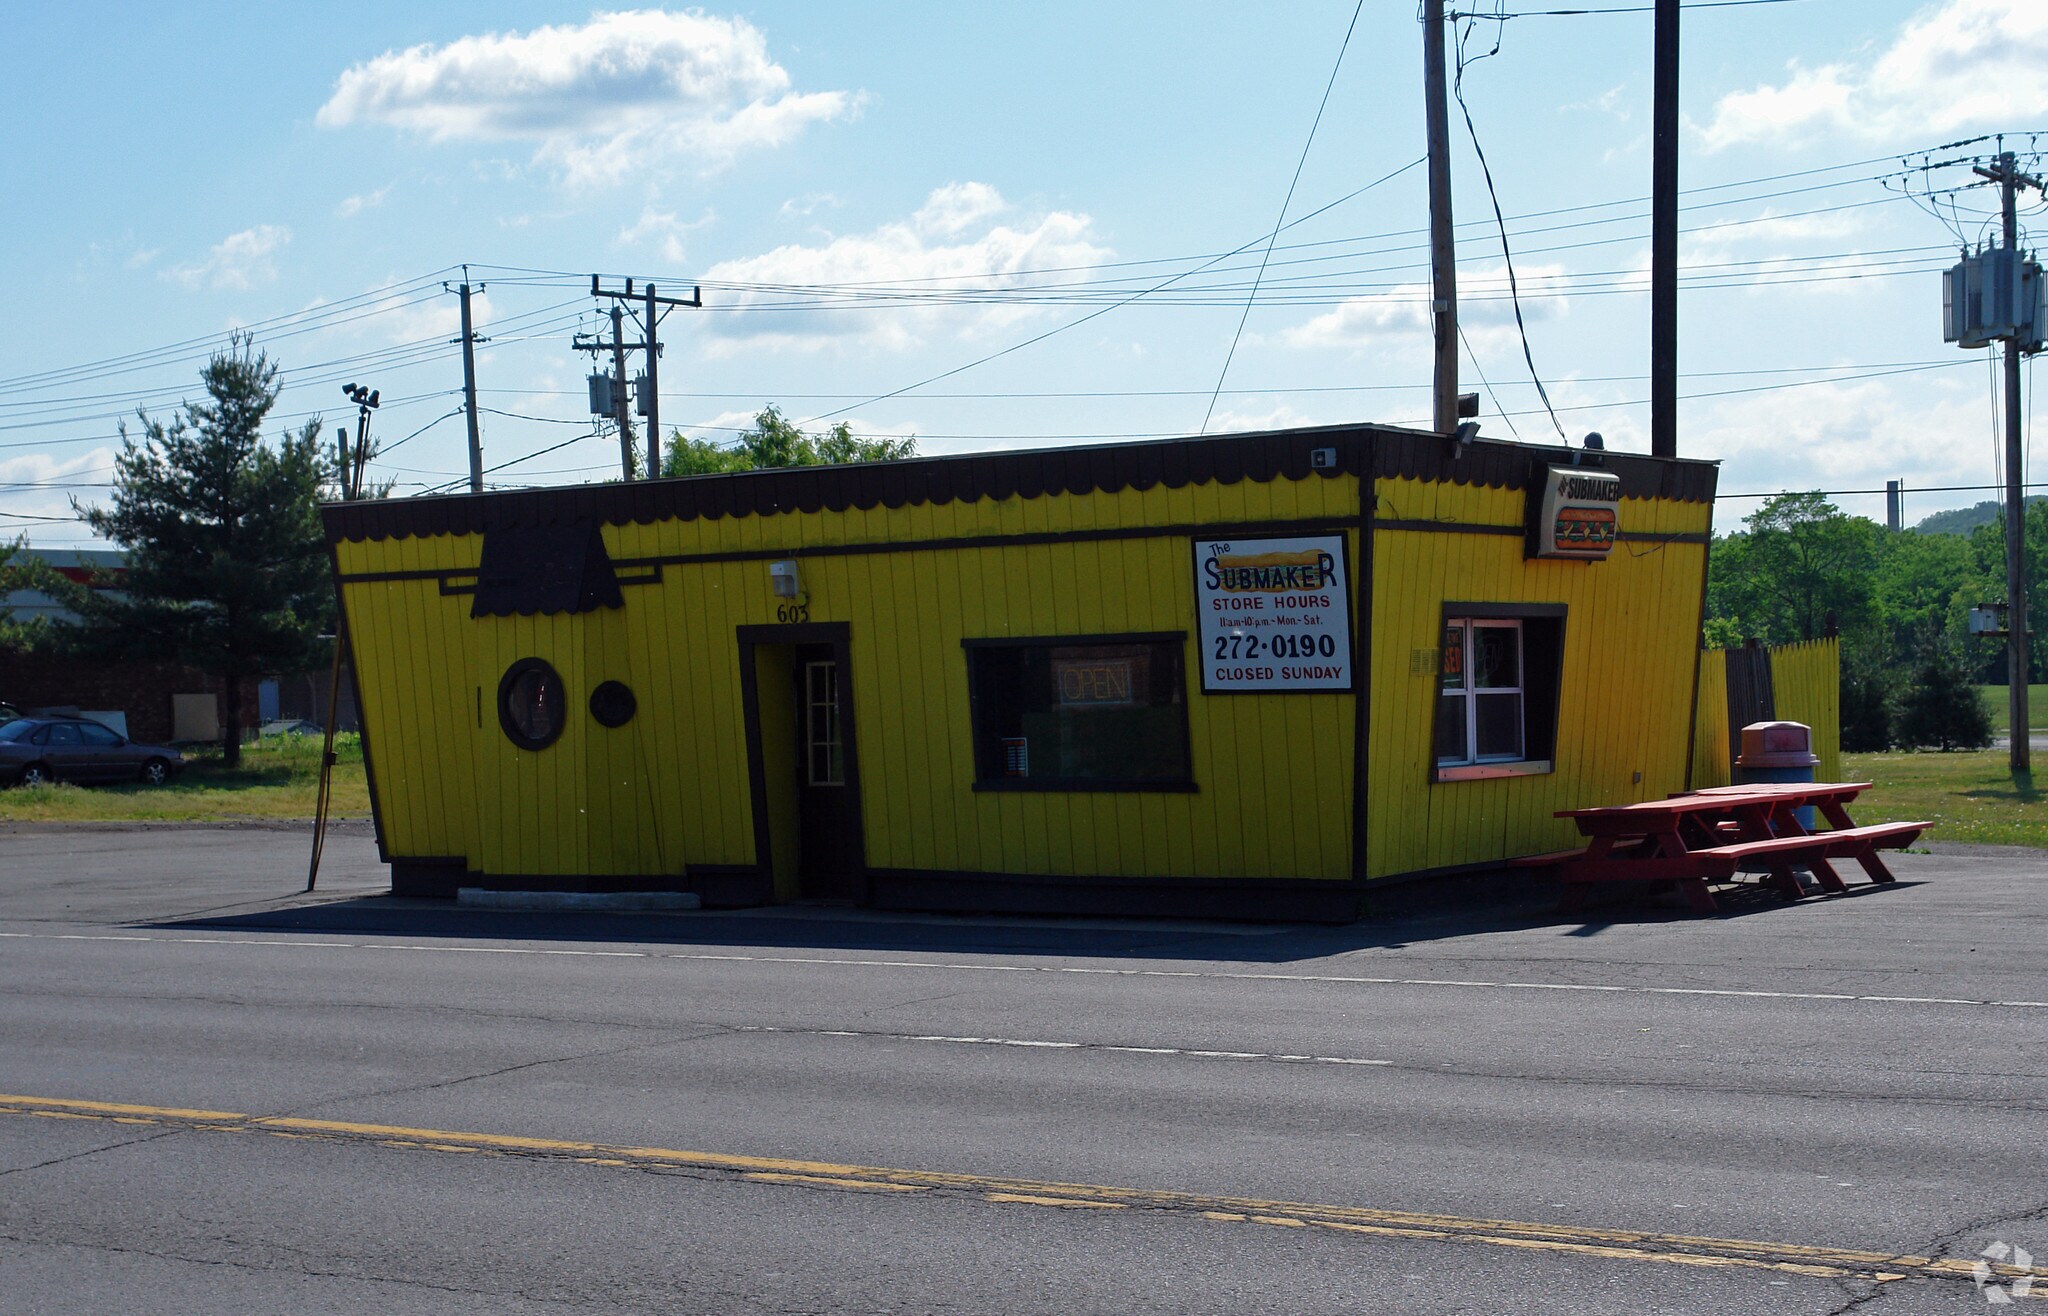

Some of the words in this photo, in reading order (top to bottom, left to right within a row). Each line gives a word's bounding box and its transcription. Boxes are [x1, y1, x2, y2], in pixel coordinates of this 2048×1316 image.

[1568, 477, 1620, 502] SUBMAKER
[1209, 543, 1231, 557] The
[1204, 553, 1338, 590] SUBMAKER
[1213, 598, 1264, 610] STORE
[1274, 595, 1330, 609] HOURS
[777, 604, 809, 624] 603
[1064, 667, 1127, 700] OPEN
[1216, 667, 1274, 681] CLOSED
[1281, 666, 1342, 679] SUNDAY
